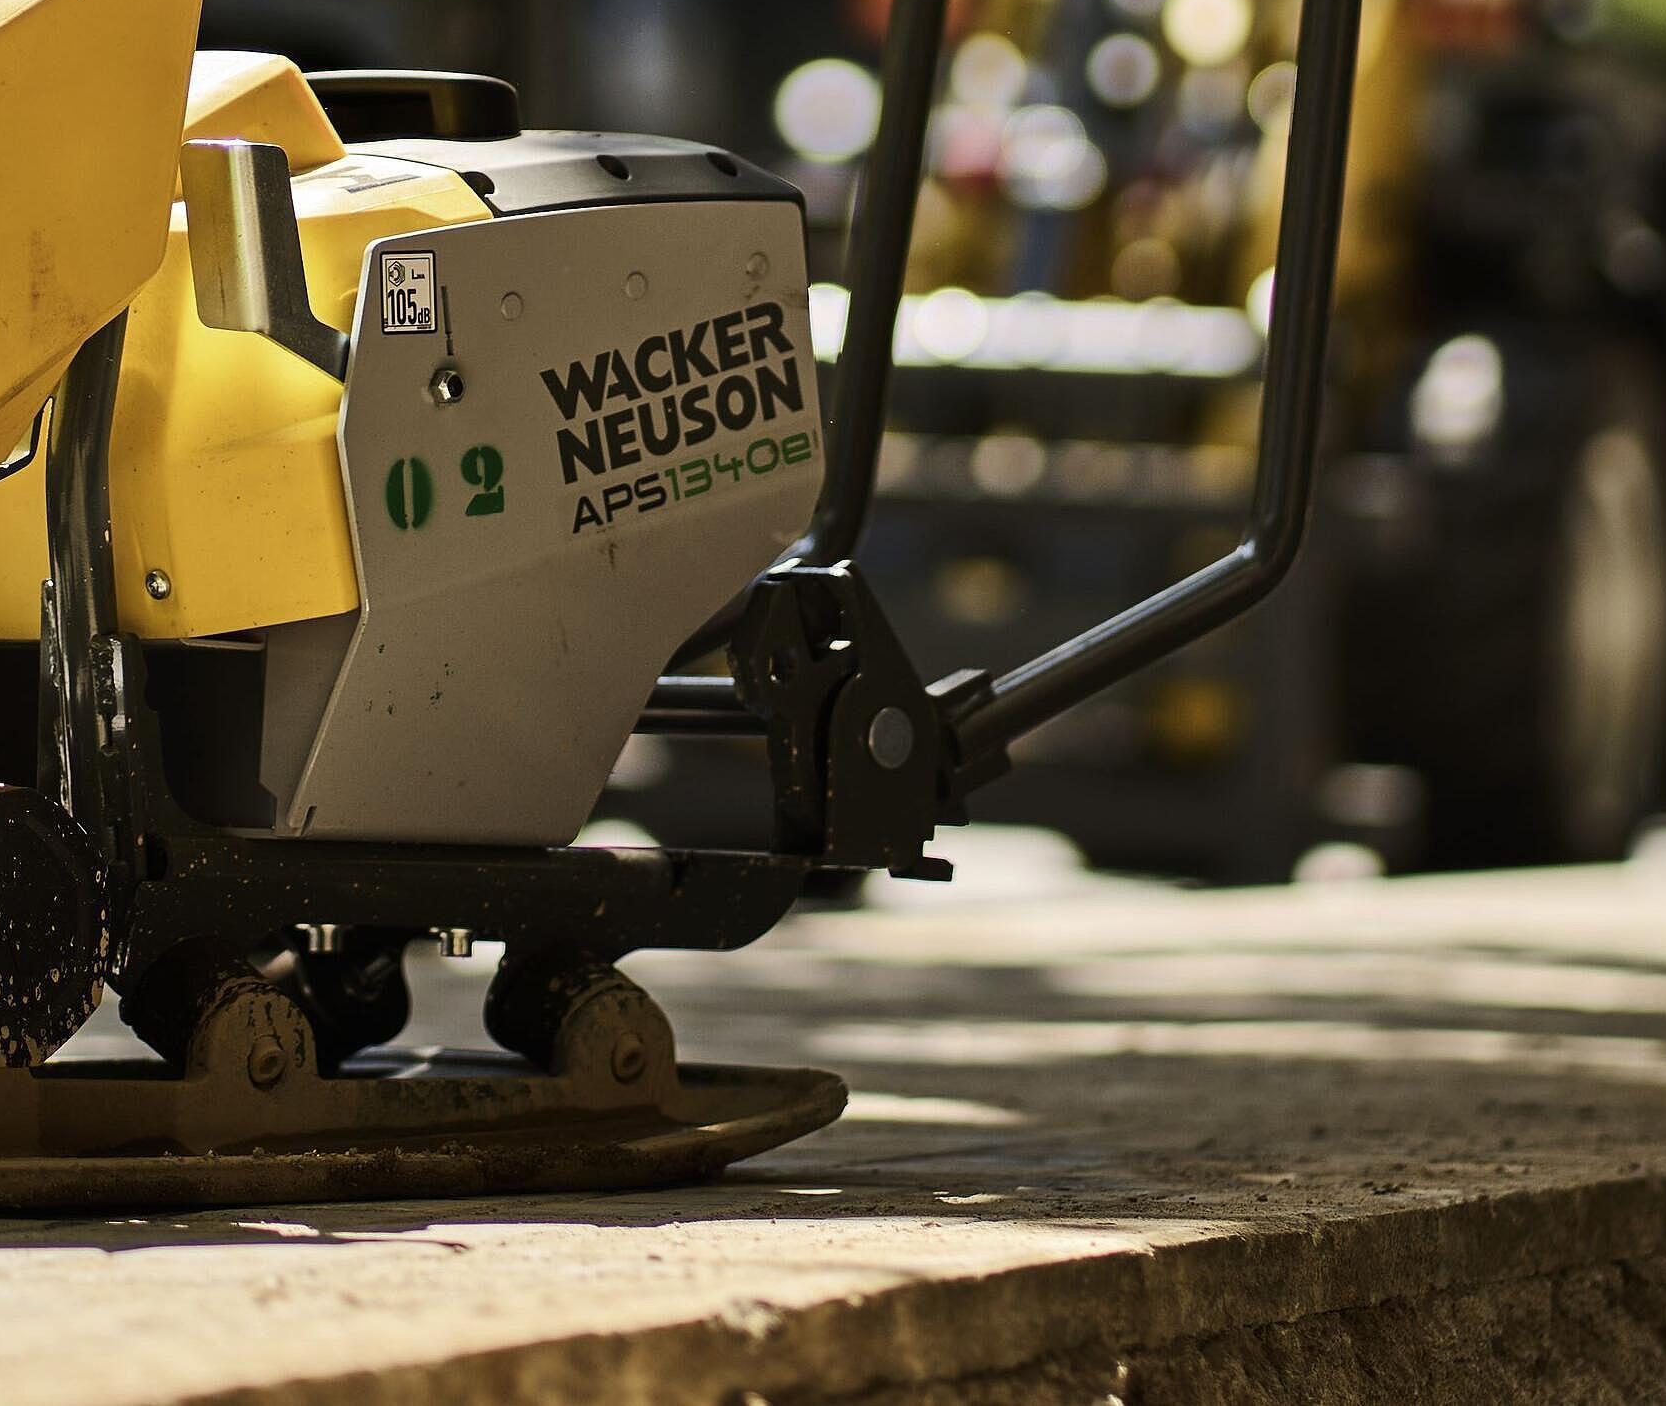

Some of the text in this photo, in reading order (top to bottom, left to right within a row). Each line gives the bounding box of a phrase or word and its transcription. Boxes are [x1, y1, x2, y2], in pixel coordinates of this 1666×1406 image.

[539, 301, 795, 421] WACKER
[556, 356, 804, 485] NEUSON
[572, 432, 812, 534] APS1340e
